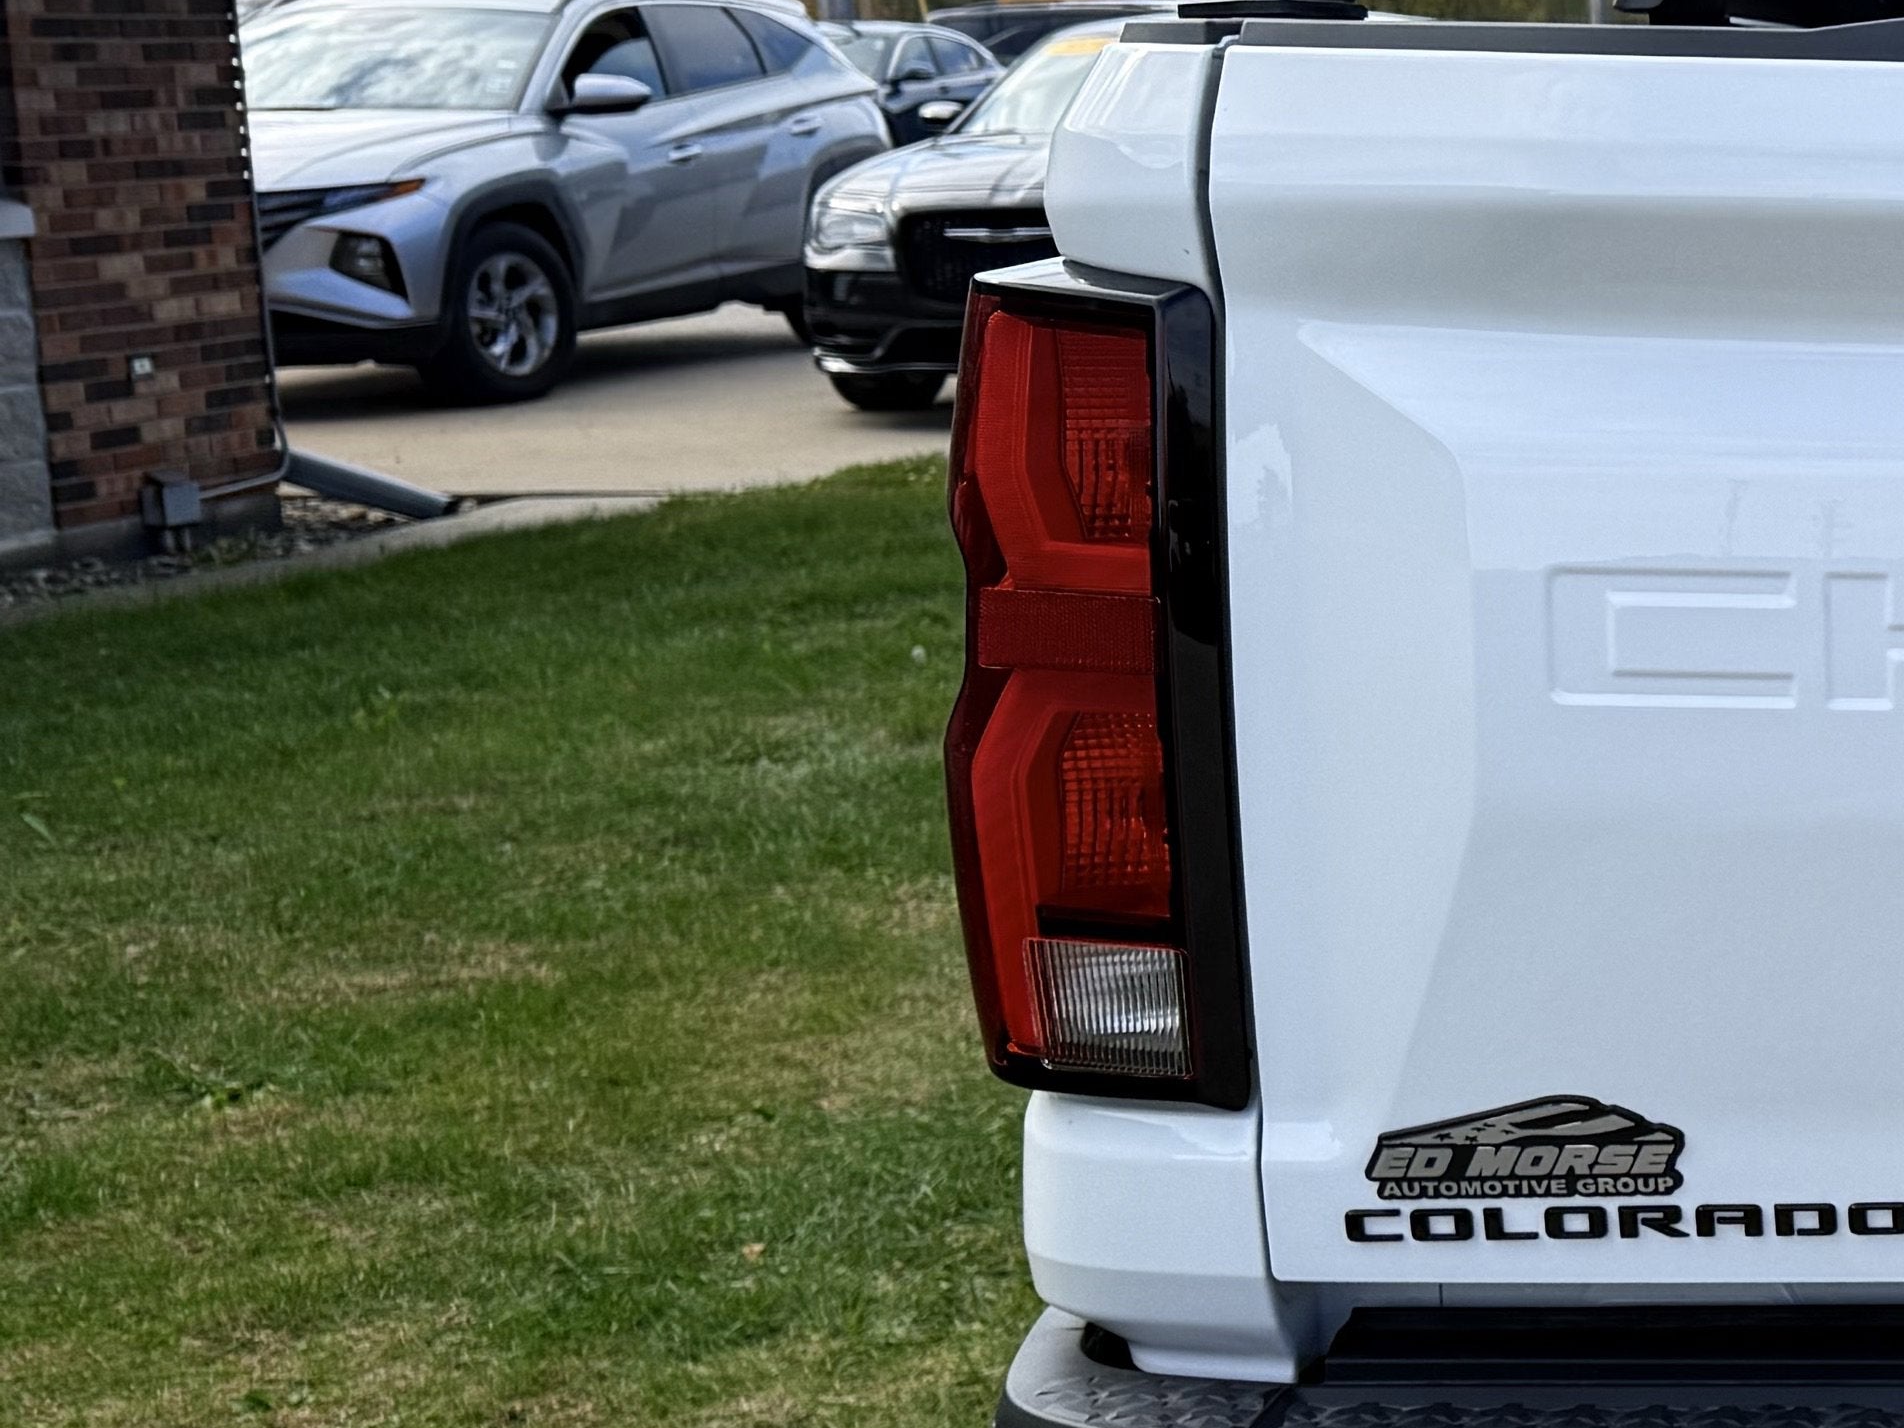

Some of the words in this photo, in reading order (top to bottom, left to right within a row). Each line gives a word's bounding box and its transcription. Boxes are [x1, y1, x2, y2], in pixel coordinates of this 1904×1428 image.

[1371, 1146, 1453, 1179] ED
[1465, 1143, 1675, 1177] MORSE
[1382, 1178, 1568, 1197] AUTOMOTIVE
[1576, 1175, 1675, 1194] GROUP
